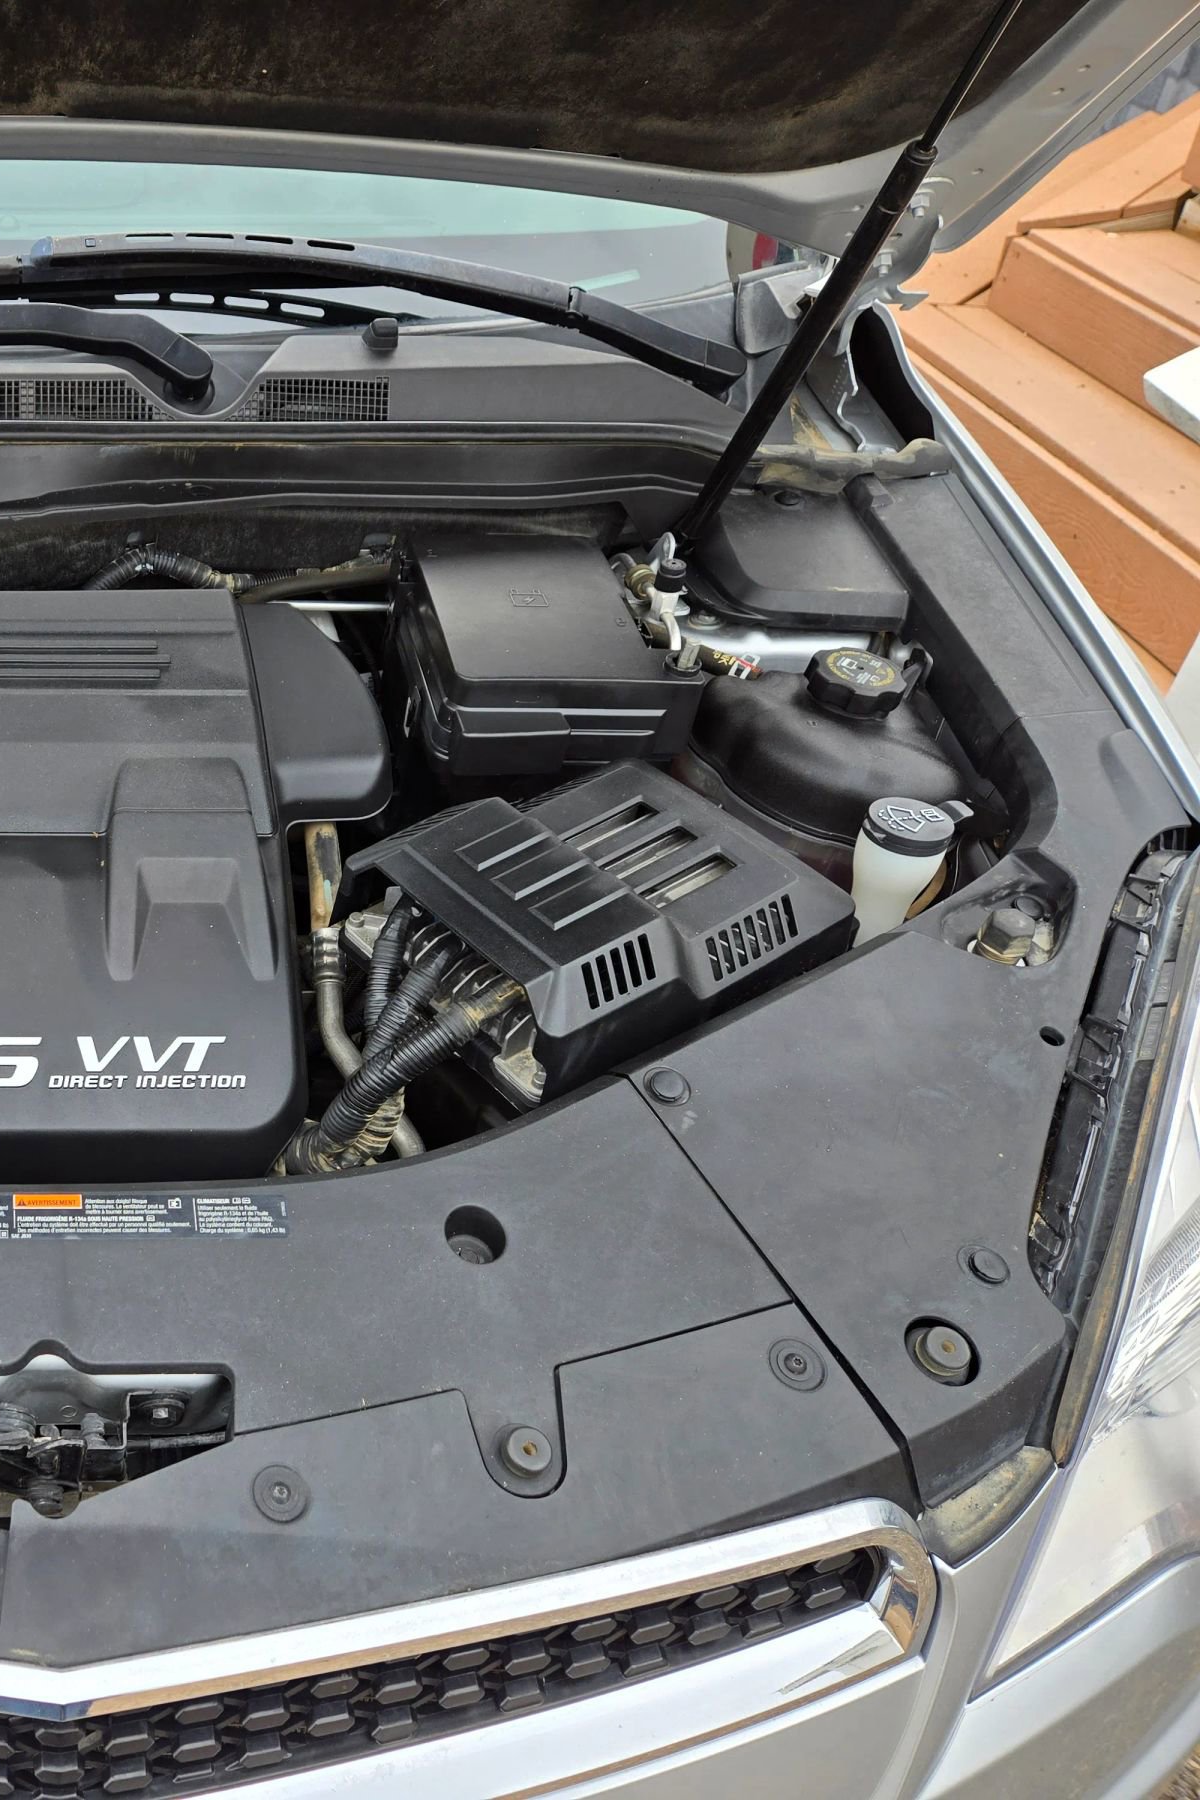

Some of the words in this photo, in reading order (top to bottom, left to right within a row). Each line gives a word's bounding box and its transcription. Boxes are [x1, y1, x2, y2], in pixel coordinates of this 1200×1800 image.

[76, 1036, 227, 1072] VVT
[49, 1074, 129, 1089] DIRECT
[135, 1074, 247, 1089] INJECTION
